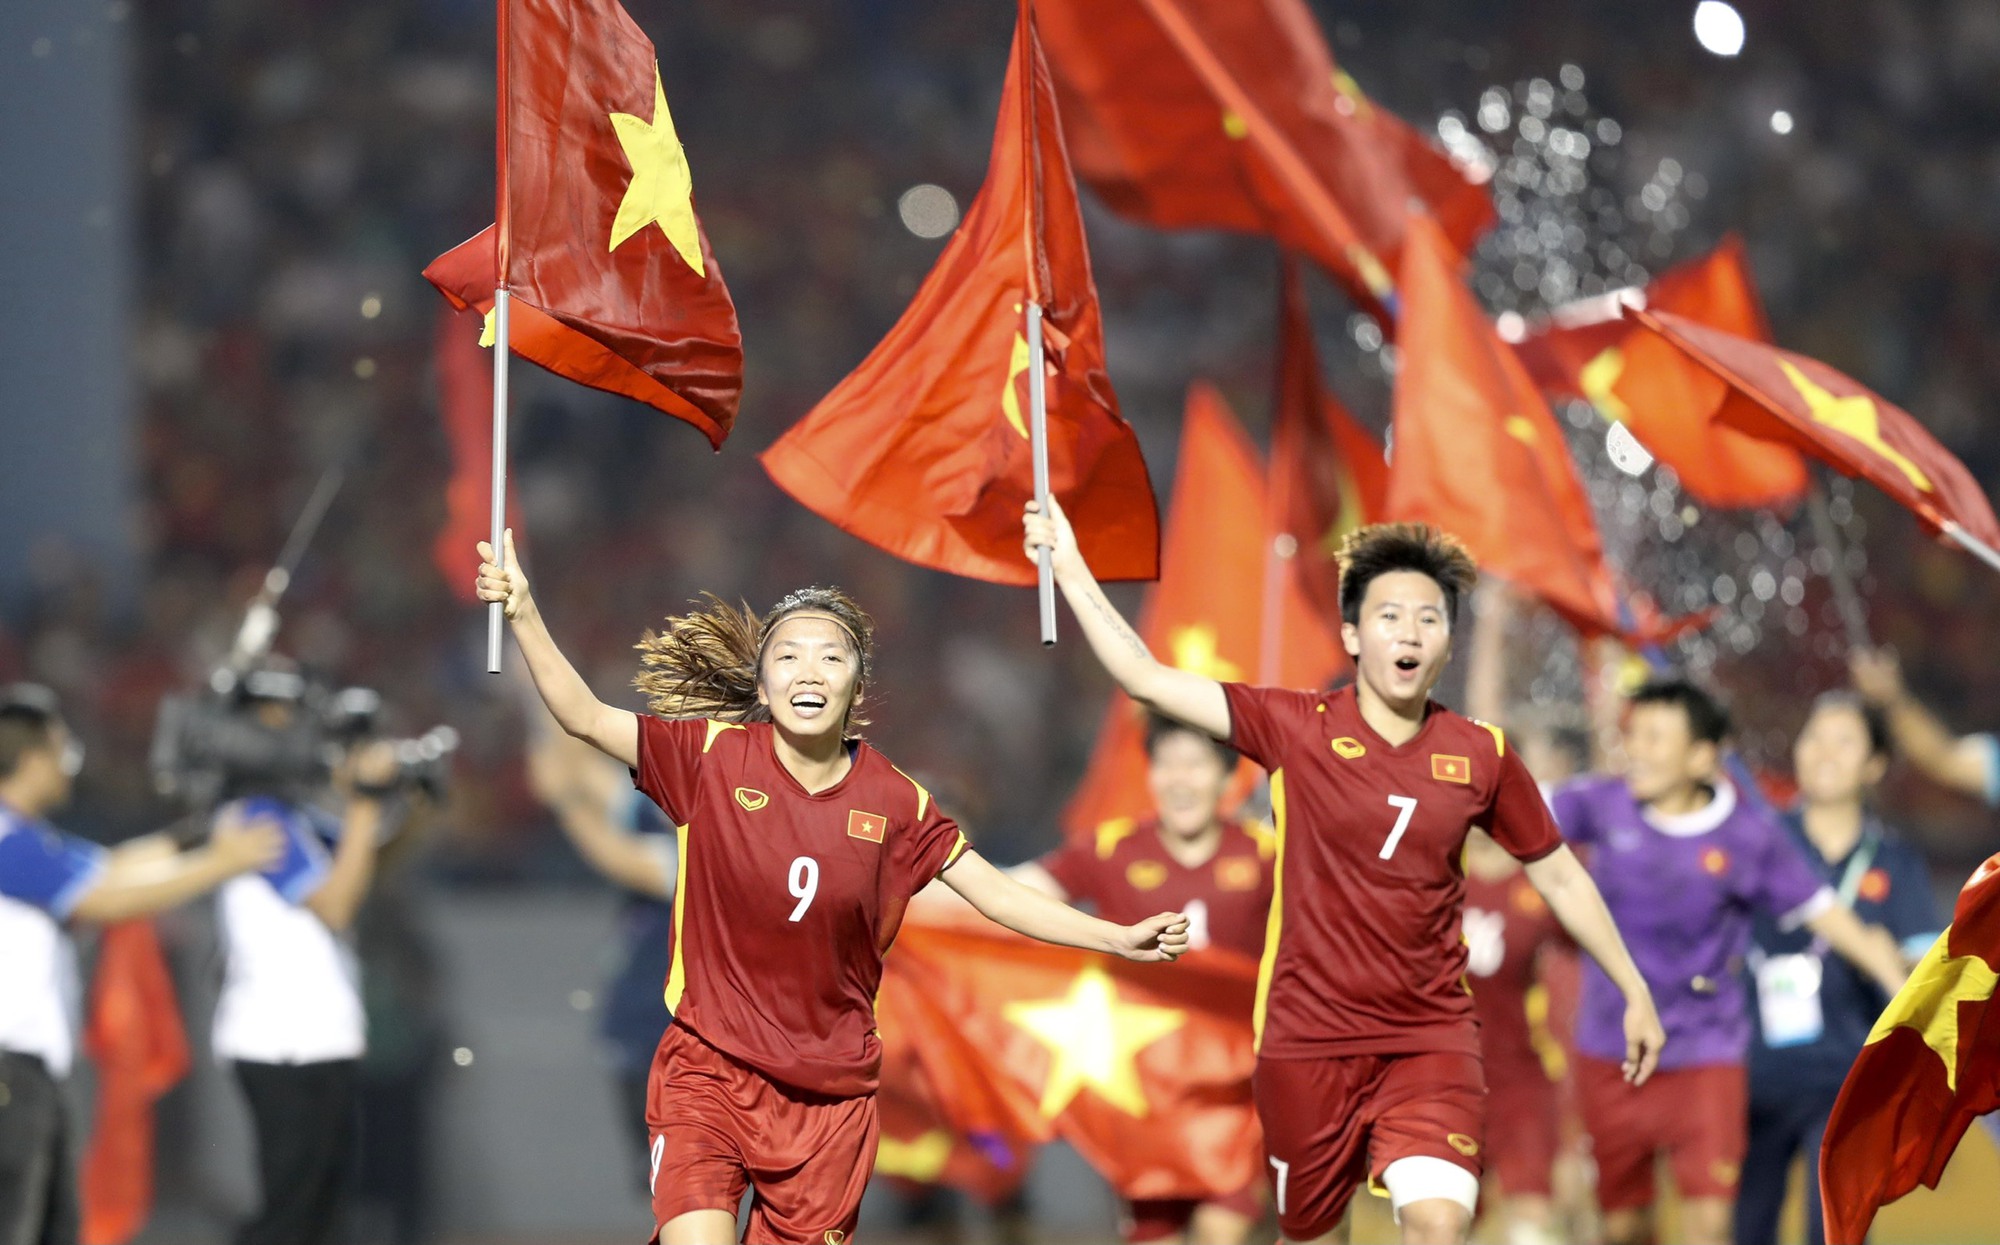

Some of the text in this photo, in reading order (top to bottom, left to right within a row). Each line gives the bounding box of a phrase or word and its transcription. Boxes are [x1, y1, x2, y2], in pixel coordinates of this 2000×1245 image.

[1379, 794, 1418, 860] 7
[787, 856, 819, 922] 9
[650, 1134, 665, 1197] 9
